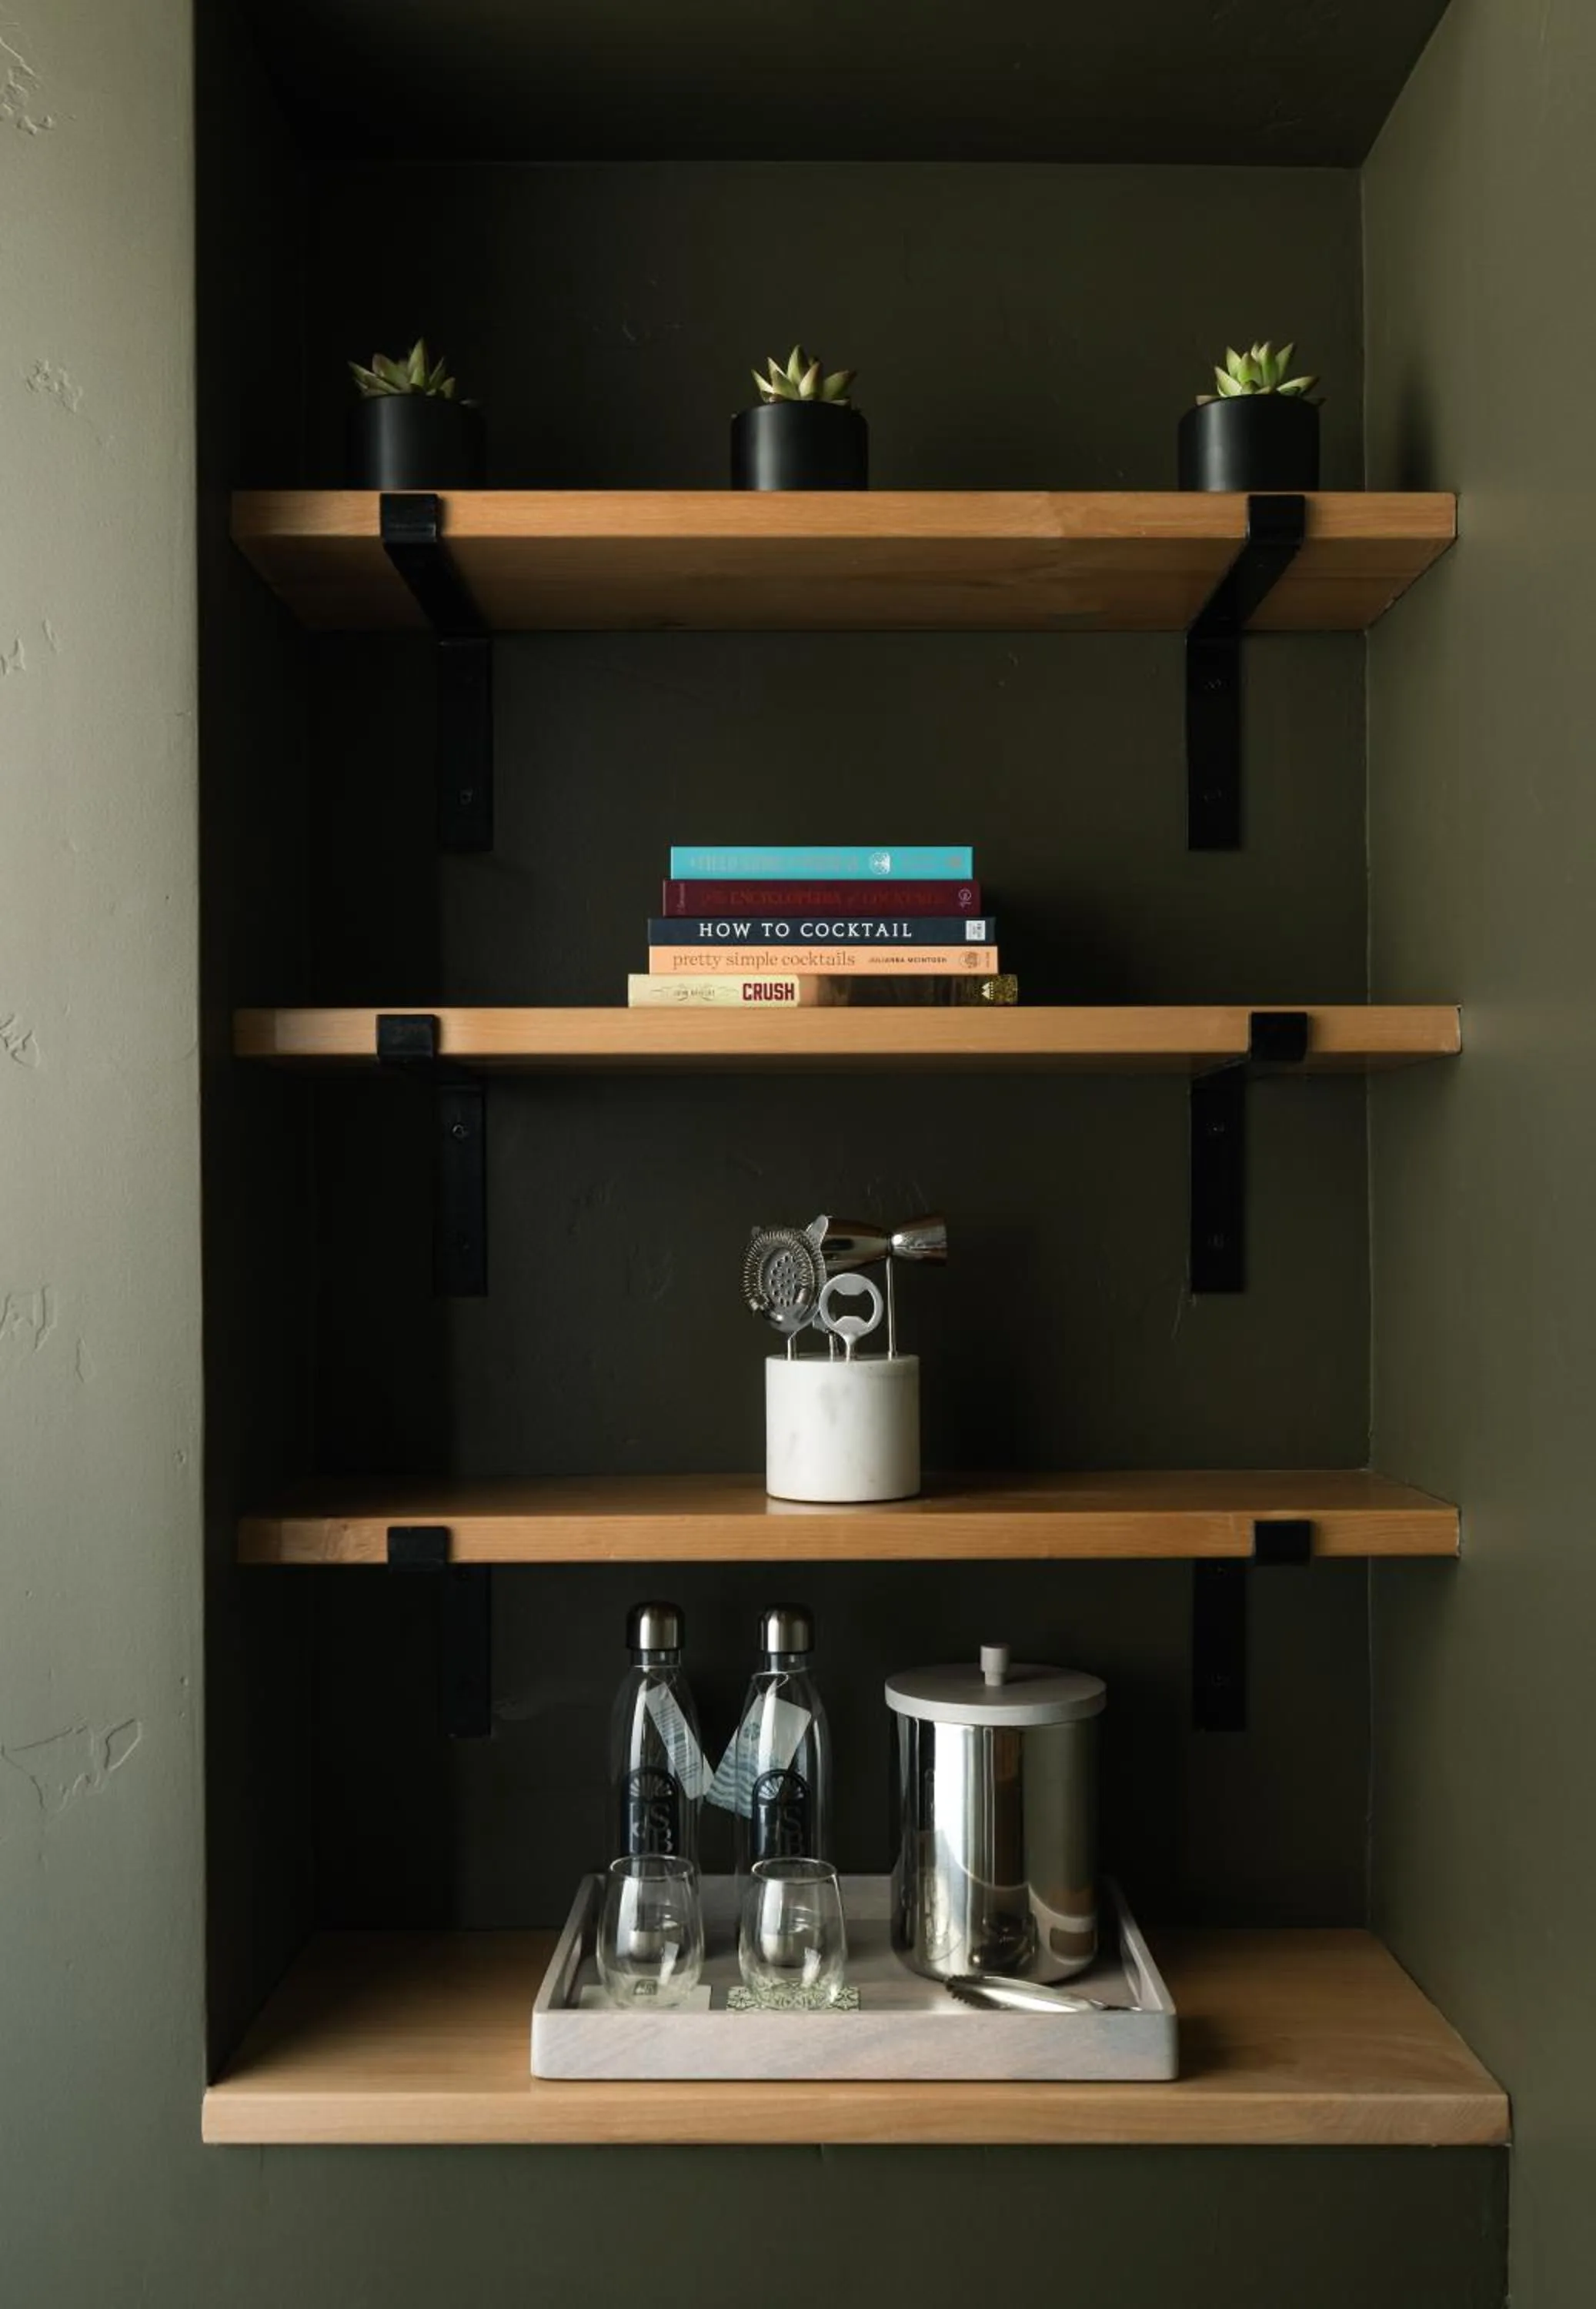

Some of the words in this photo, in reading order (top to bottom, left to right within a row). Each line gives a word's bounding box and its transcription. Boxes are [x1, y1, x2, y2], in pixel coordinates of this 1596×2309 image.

[699, 923, 751, 937] HOW
[761, 923, 791, 937] TO
[800, 923, 913, 937] COCKTAIL
[673, 952, 721, 970] pretty
[726, 951, 779, 967] simple
[780, 951, 856, 967] cocktails
[742, 982, 796, 1001] CRUSH
